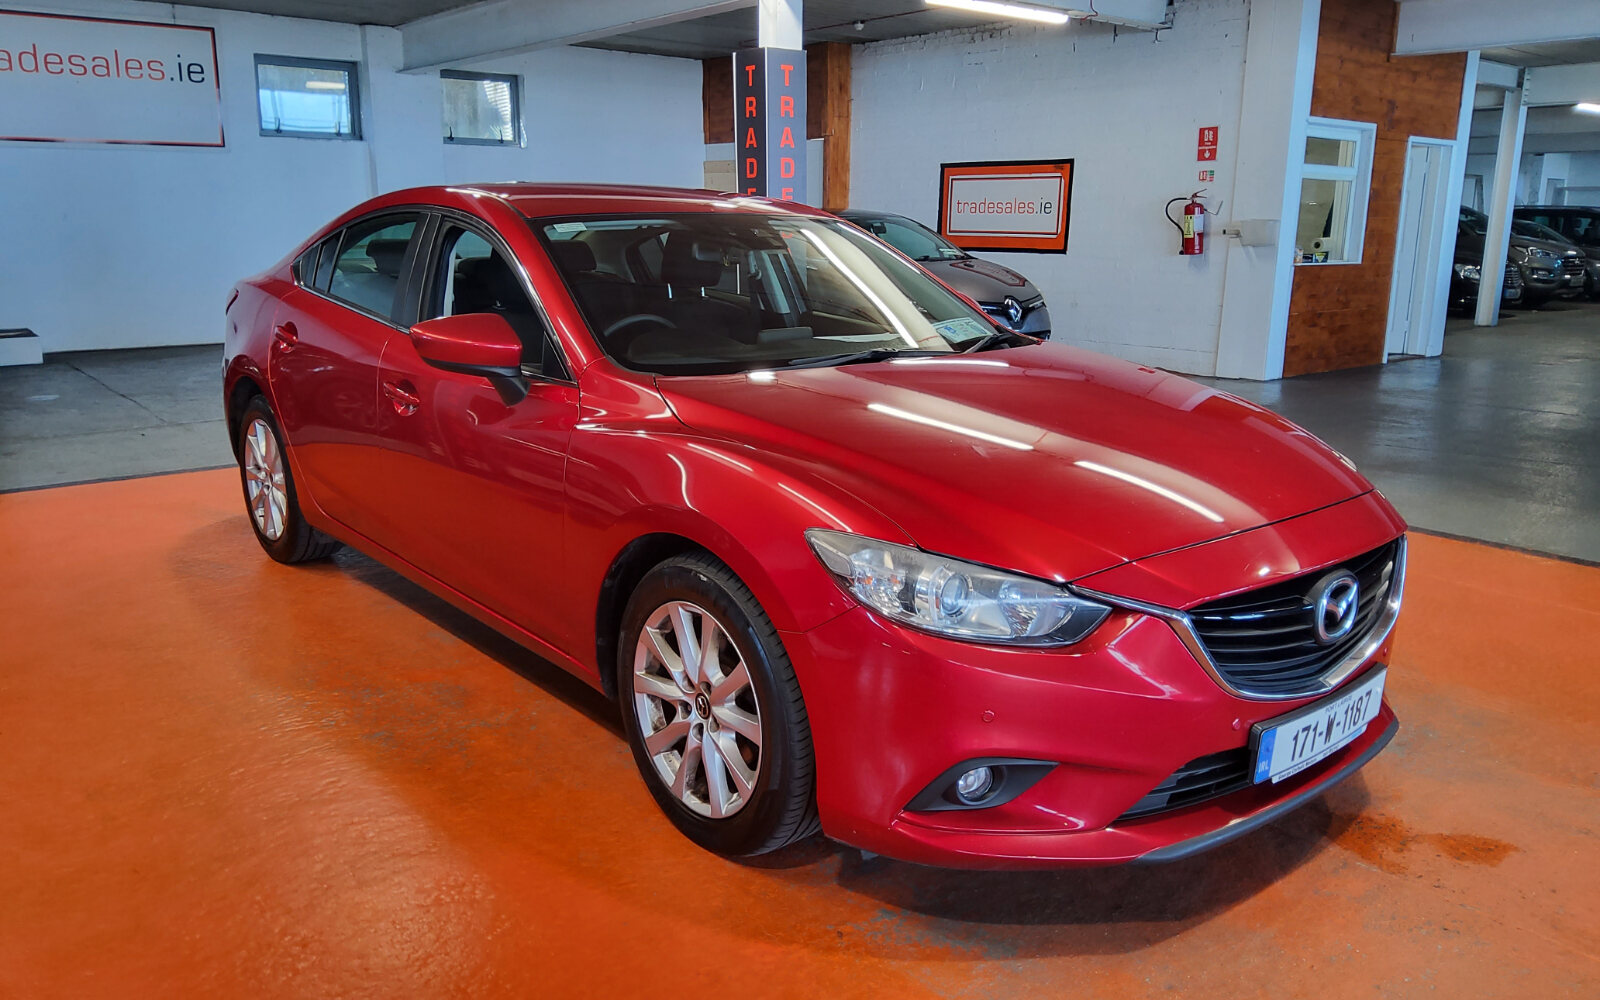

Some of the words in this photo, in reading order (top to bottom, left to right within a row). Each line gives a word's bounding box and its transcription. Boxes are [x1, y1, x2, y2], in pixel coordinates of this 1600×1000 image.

[956, 197, 1053, 215] tradesales.ie
[1291, 689, 1373, 762] 171-W-1187
[1258, 761, 1270, 773] IRL
